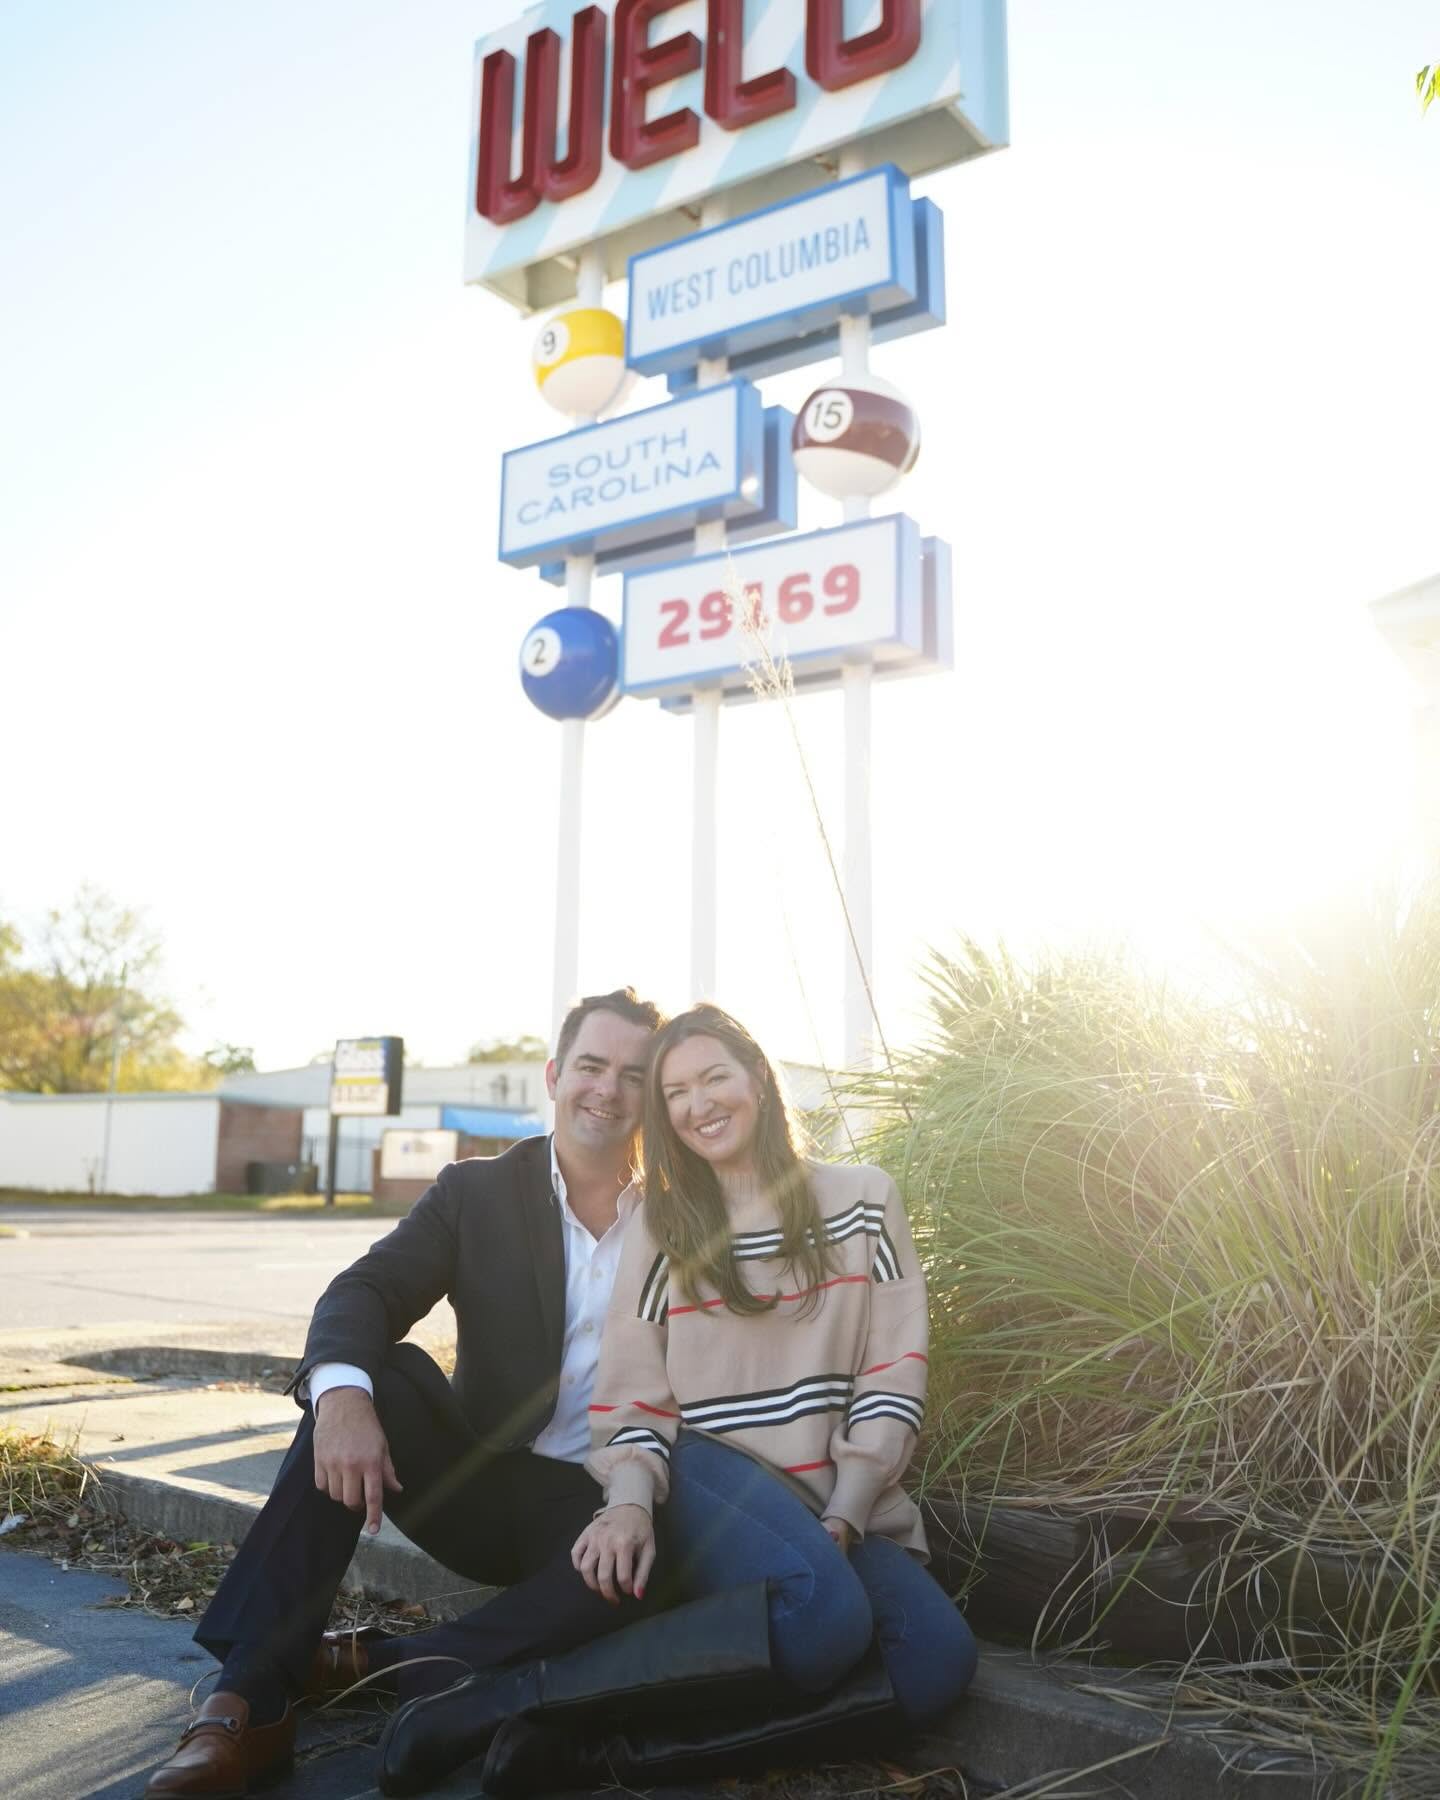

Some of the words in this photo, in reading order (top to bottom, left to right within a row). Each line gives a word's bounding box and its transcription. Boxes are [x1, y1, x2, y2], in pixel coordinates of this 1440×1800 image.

[647, 266, 717, 320] WEST
[726, 216, 870, 296] COLUMBIA
[541, 330, 556, 356] 9
[813, 401, 845, 430] 15
[516, 450, 721, 525] CAROLINA
[547, 427, 688, 488] SOUTH
[657, 562, 860, 650] 29169
[531, 637, 547, 665] 2
